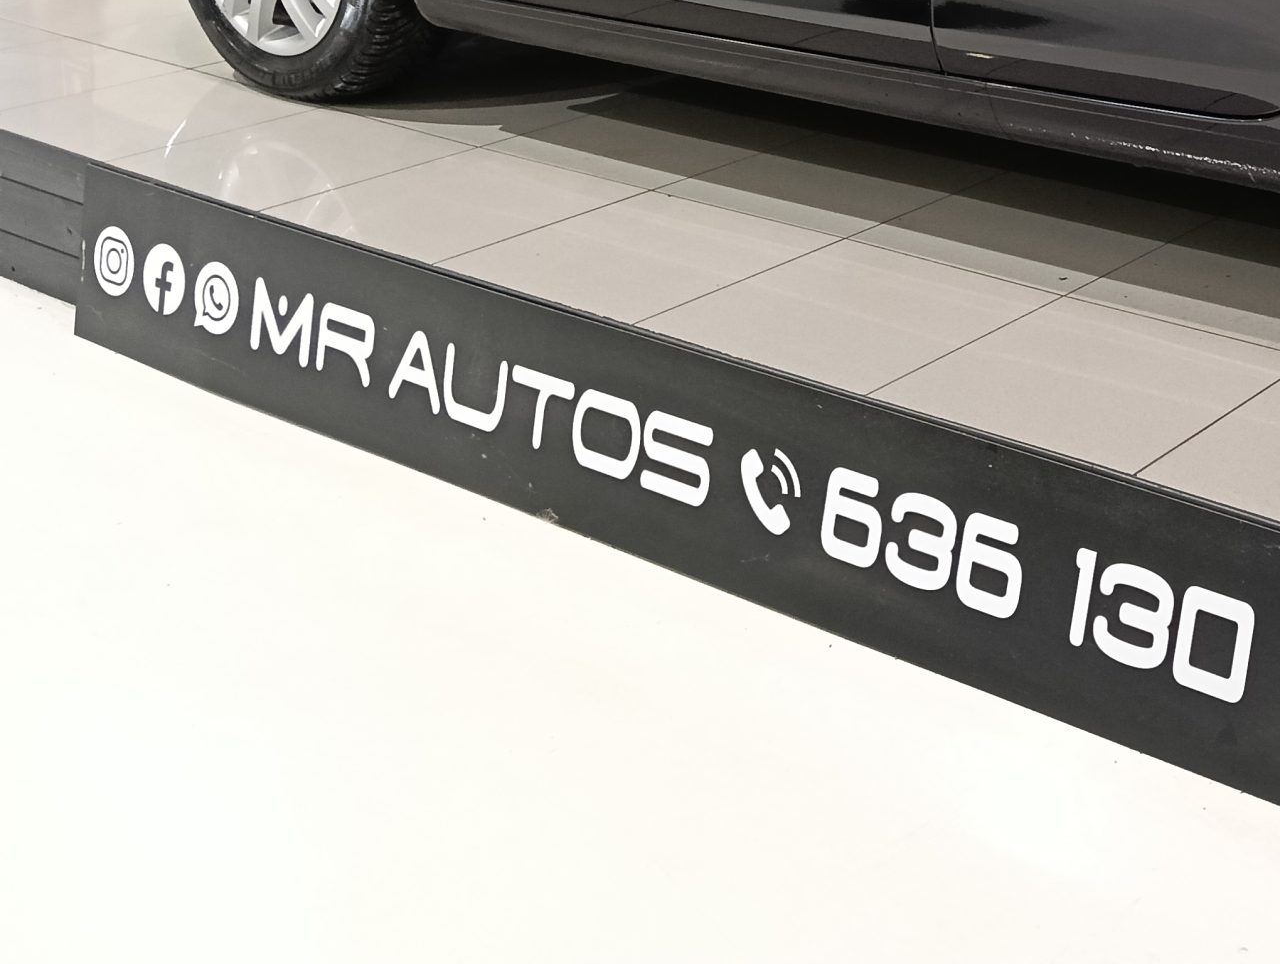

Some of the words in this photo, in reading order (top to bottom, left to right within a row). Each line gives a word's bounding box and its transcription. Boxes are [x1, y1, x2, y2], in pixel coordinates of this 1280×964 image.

[249, 276, 376, 388] MR
[388, 330, 714, 507] AUTOS
[820, 466, 1023, 619] 636
[1069, 547, 1255, 704] 130
